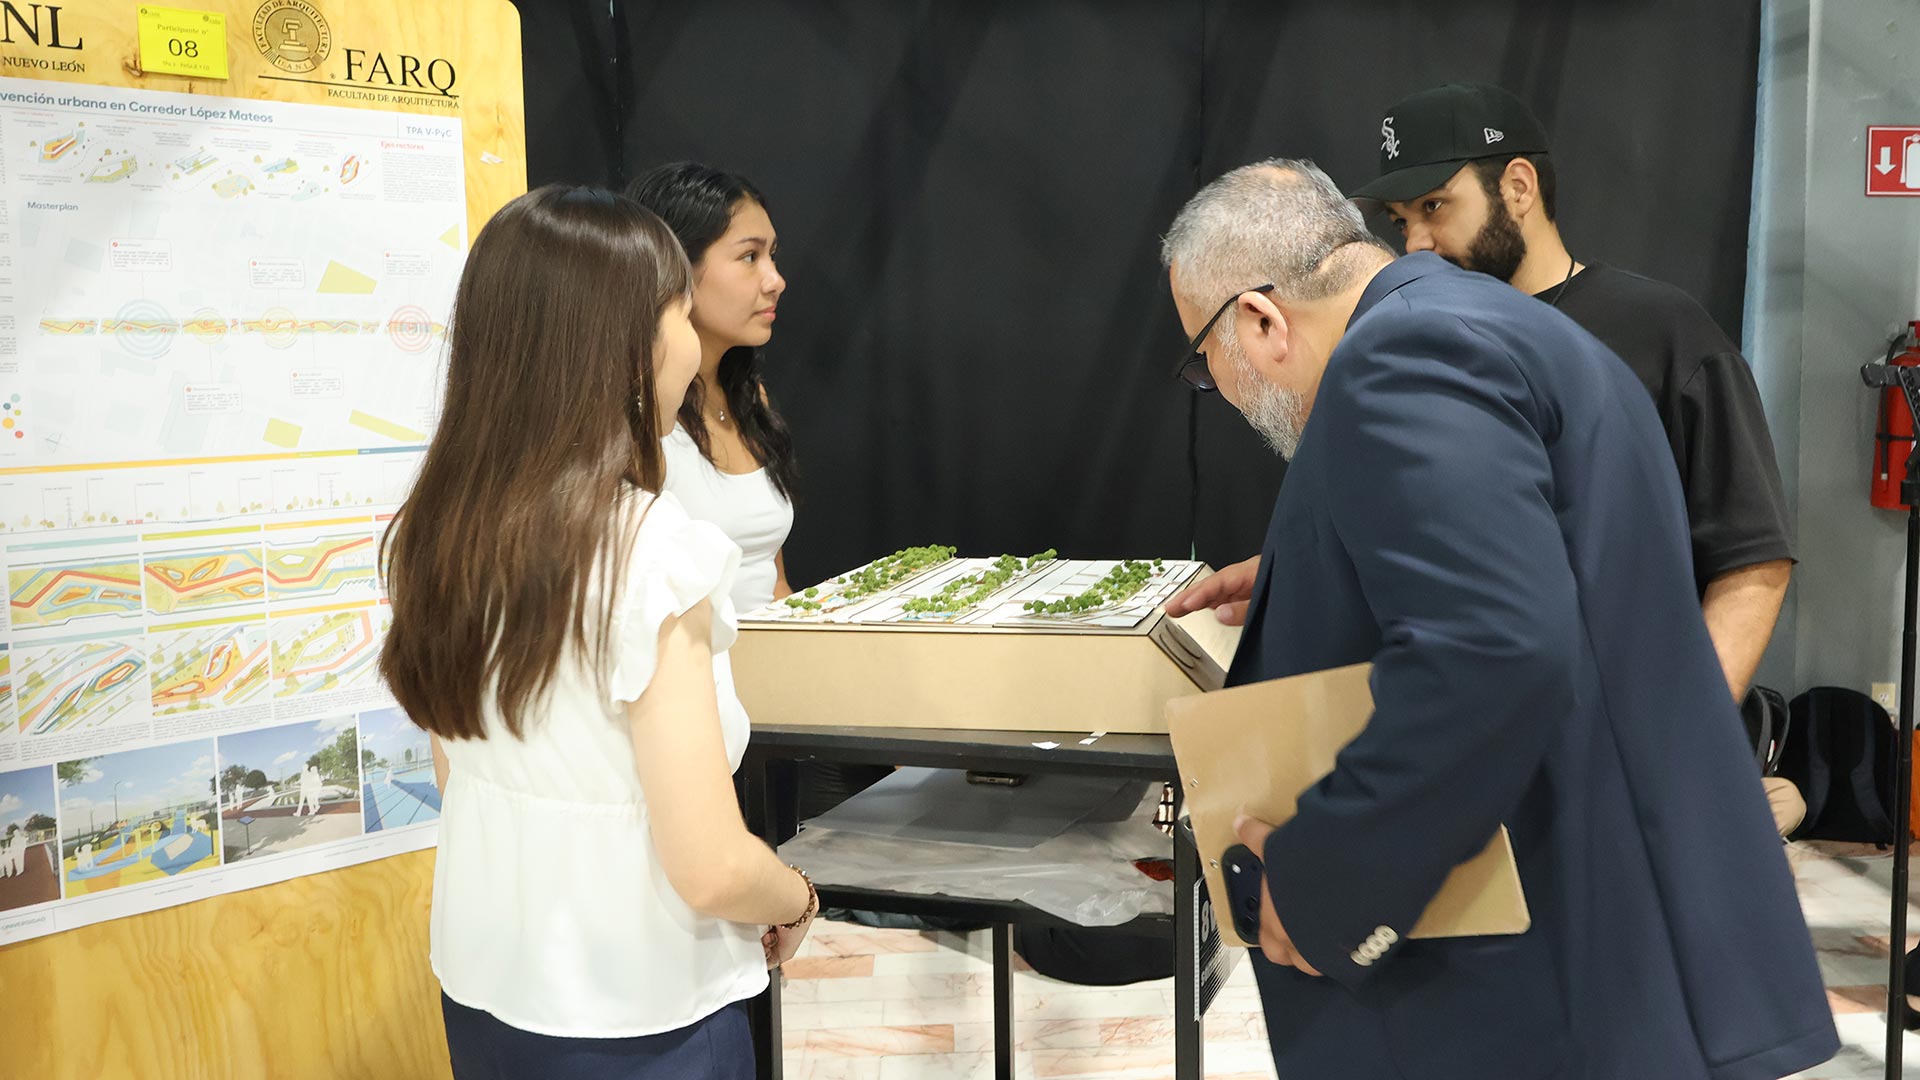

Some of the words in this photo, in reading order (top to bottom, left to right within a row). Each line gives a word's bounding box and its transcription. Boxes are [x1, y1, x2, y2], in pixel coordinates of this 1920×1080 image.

[168, 38, 199, 58] 08
[3, 56, 49, 70] NUEVO
[52, 60, 86, 73] LEÓN
[342, 48, 458, 99] FARQ
[328, 89, 376, 101] FACULTAD
[377, 94, 390, 103] DE
[391, 96, 460, 109] ARQUITECTURA
[58, 96, 107, 109] urbana
[110, 102, 126, 111] en
[129, 101, 187, 116] Corredor
[190, 106, 226, 120] López
[229, 109, 273, 123] Mateos
[406, 126, 423, 135] TPA
[27, 201, 79, 212] Masterplan
